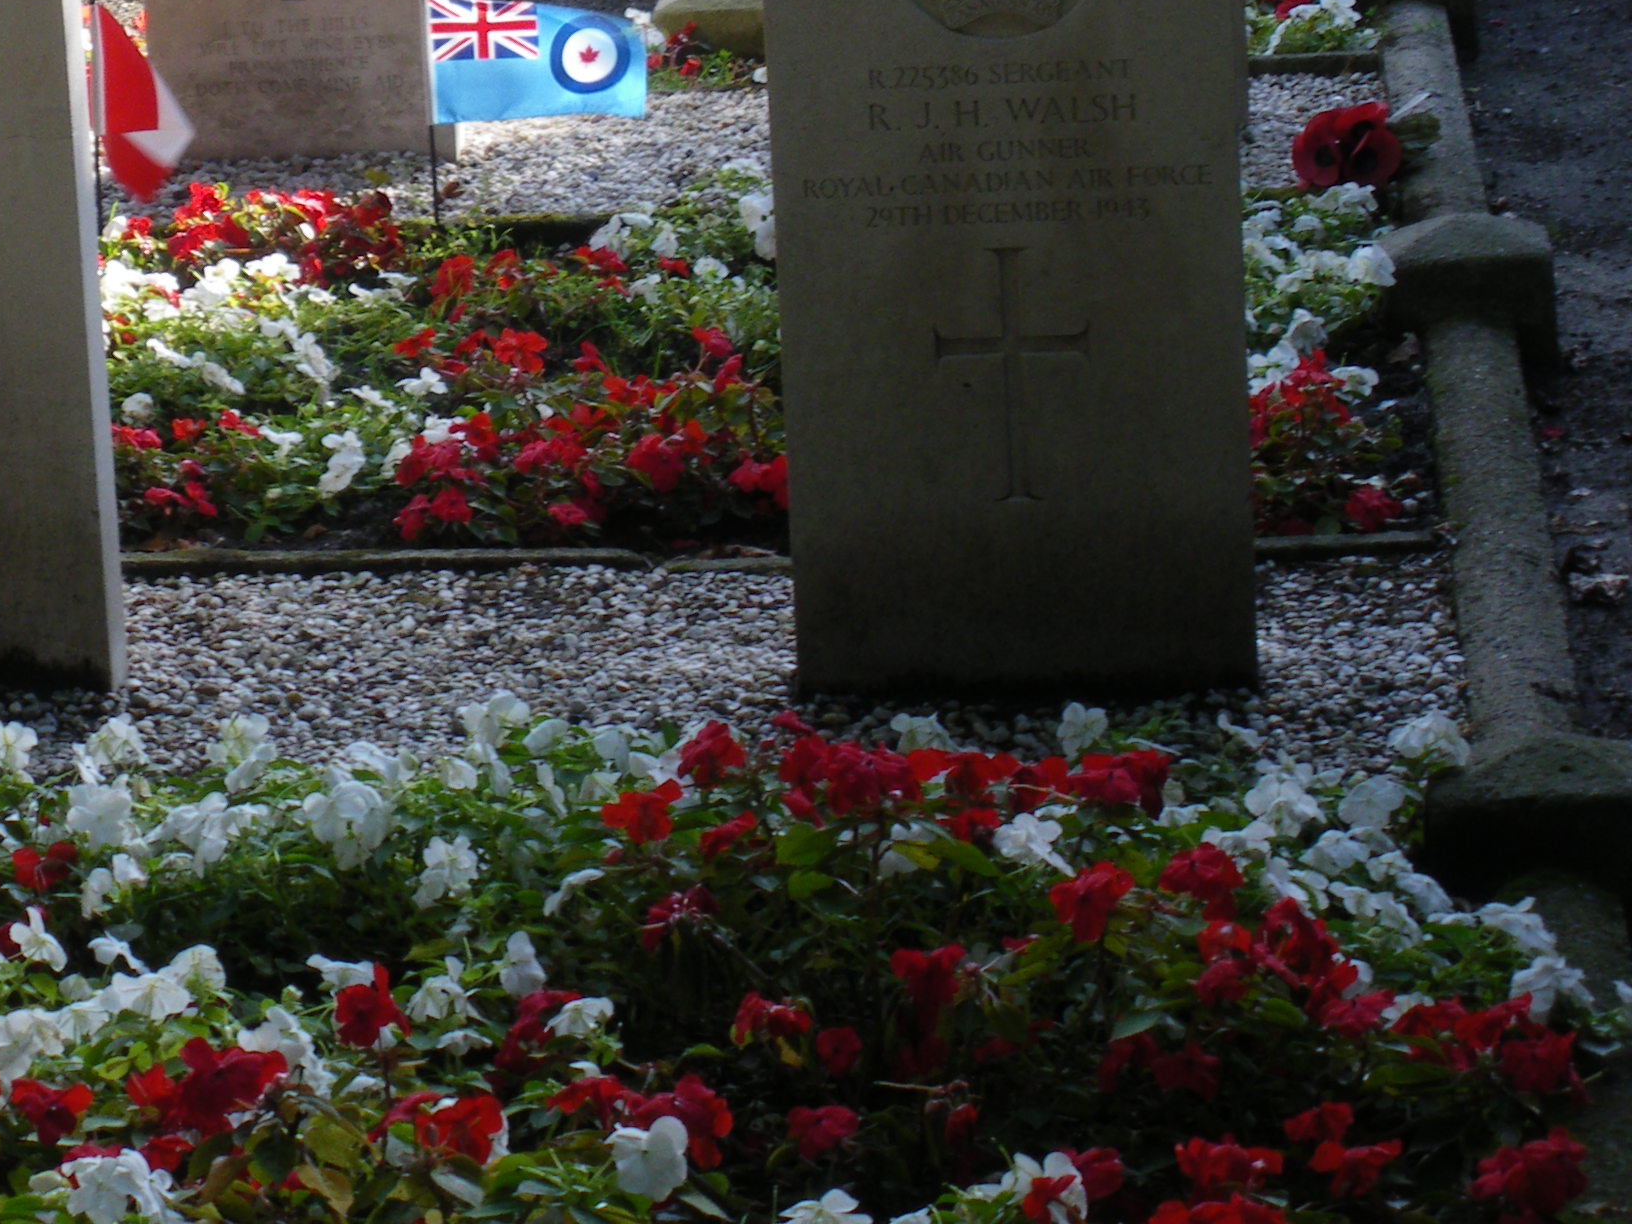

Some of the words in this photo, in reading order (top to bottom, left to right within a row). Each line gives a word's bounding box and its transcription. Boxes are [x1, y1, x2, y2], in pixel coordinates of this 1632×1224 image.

[987, 57, 1135, 86] SERGEANT
[869, 102, 902, 132] R.
[914, 100, 941, 131] J.
[954, 97, 990, 128] H.
[1005, 92, 1138, 125] WALSH
[917, 141, 966, 164] AIR
[976, 137, 1093, 163] GUNNER
[801, 176, 895, 200] ROYAL
[899, 169, 1058, 197] CANADIAN
[1067, 165, 1114, 190] AIR
[1126, 162, 1214, 188] FORCE
[866, 204, 933, 229] 29TH
[942, 200, 1084, 227] DECEMBER
[1094, 196, 1152, 222] 1943
